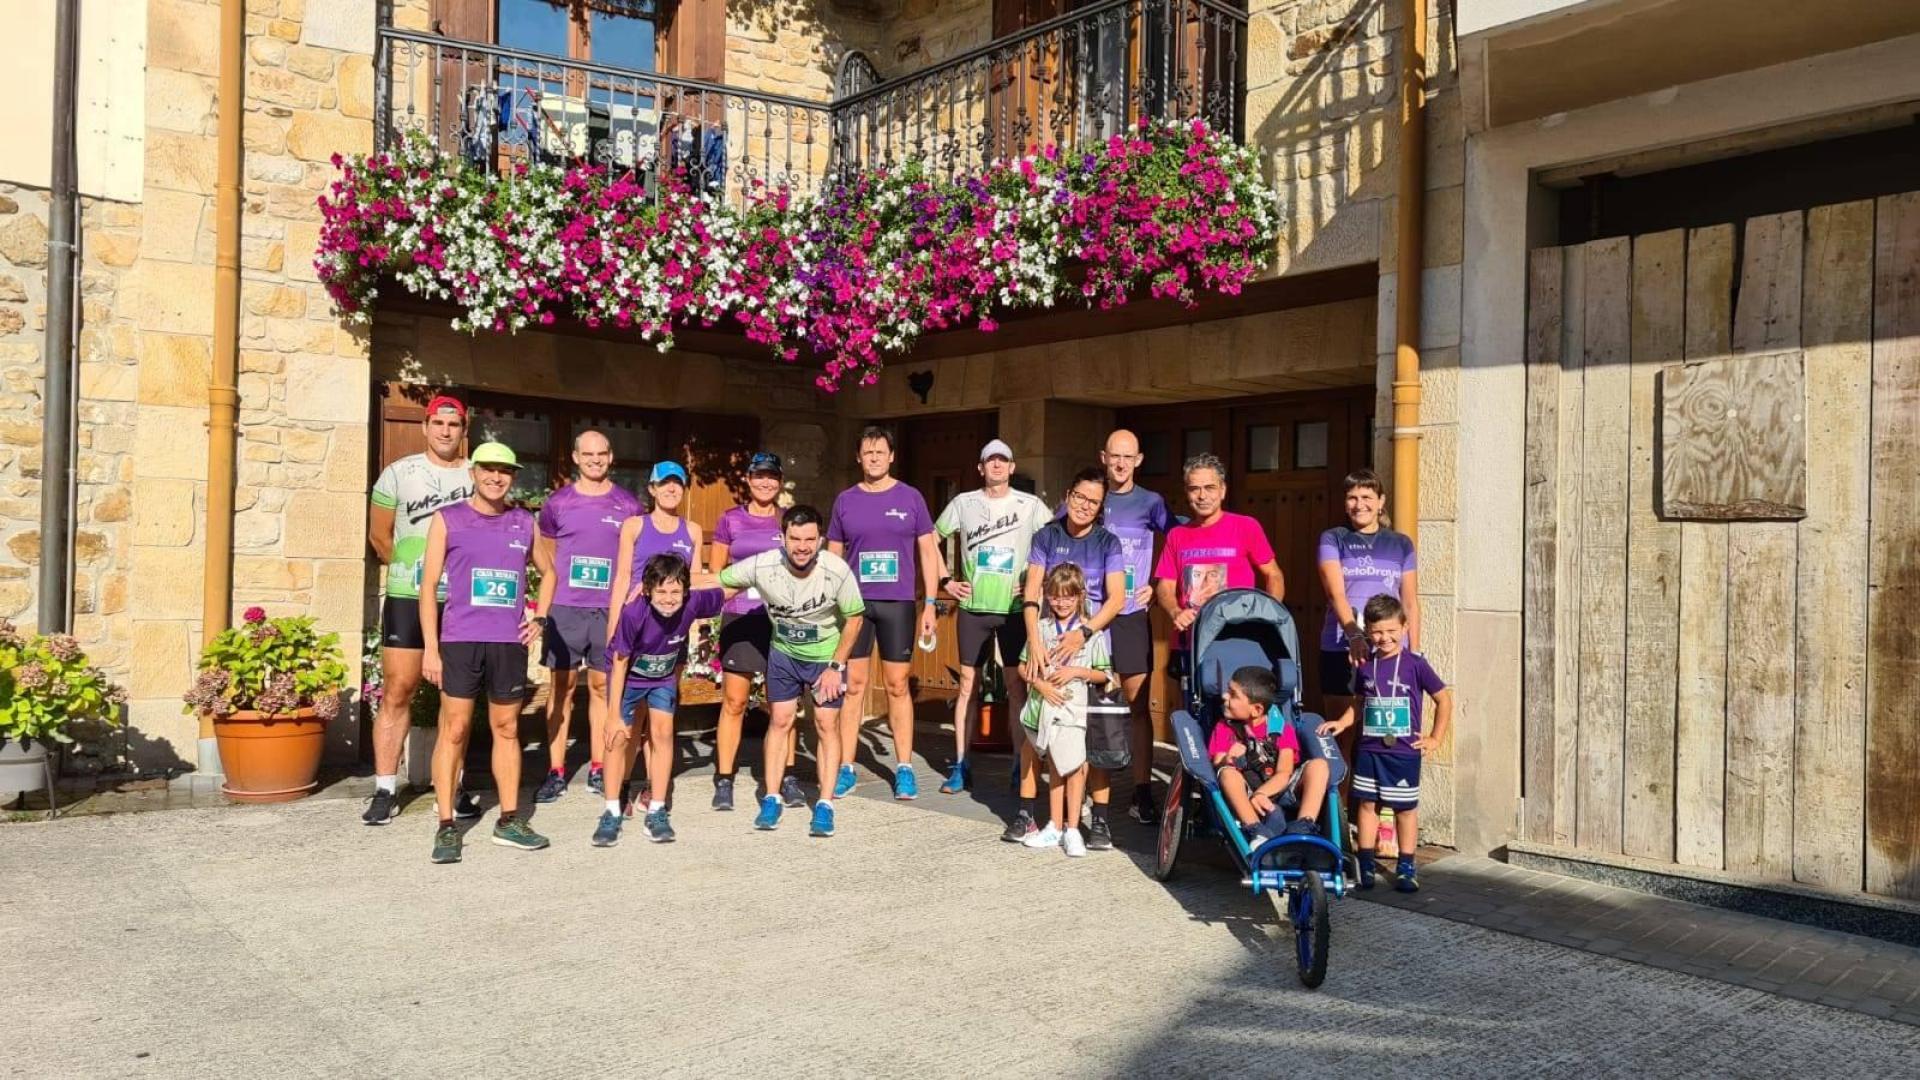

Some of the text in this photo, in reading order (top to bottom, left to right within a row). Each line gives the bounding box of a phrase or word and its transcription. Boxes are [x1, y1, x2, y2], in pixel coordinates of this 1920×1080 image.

[581, 567, 598, 580] 51
[869, 562, 887, 574] 54
[486, 581, 508, 597] 26
[787, 629, 806, 639] 50
[647, 662, 667, 672] 56
[1374, 710, 1396, 727] 19
